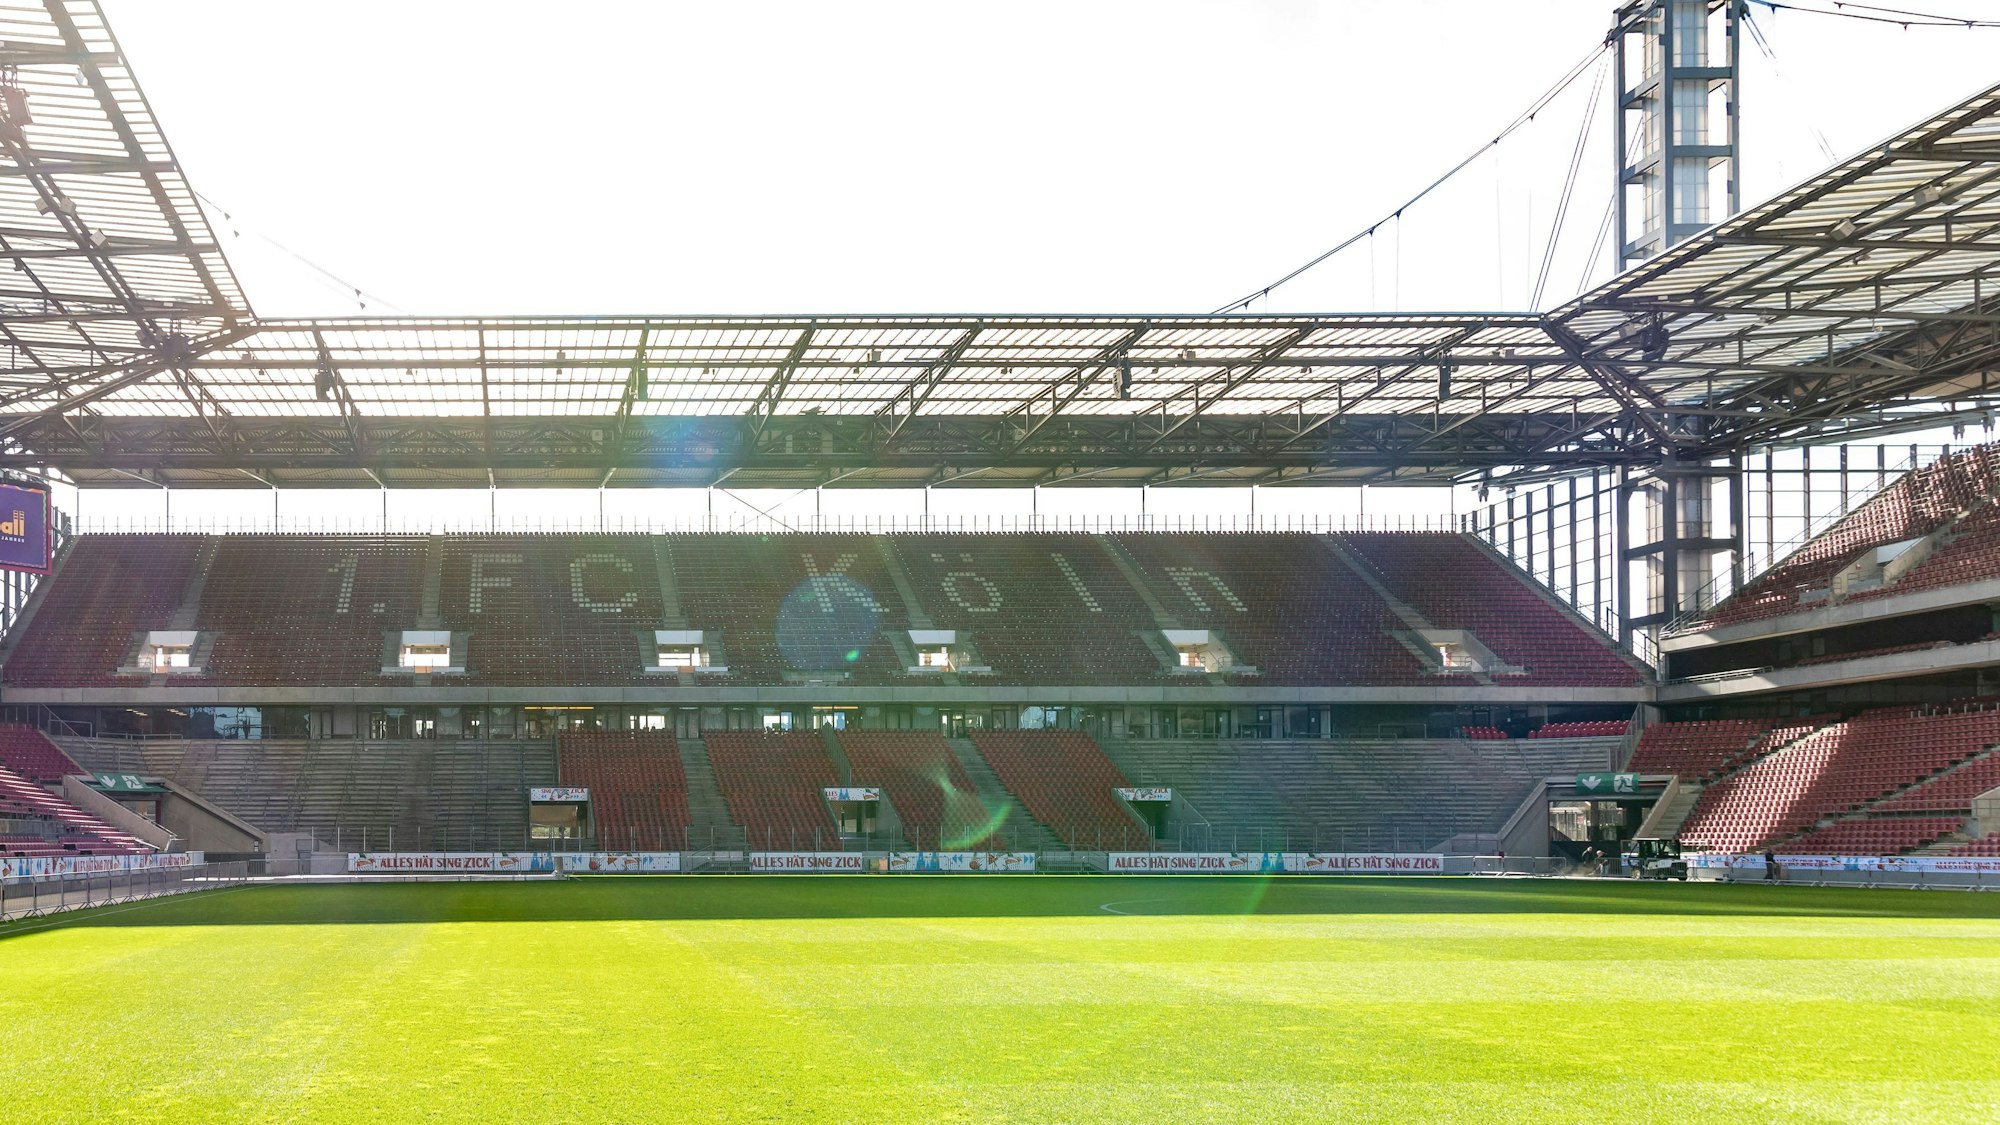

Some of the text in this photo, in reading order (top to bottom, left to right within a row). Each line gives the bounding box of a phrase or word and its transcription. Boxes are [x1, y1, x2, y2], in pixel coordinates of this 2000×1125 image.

[0, 510, 25, 537] all
[328, 553, 1248, 613] 1. FC Köln
[381, 855, 490, 868] ALLES HÄT SING ZICK
[752, 855, 861, 868] ALLES HÄT SING ZICK
[1115, 856, 1225, 868] ALLES HÄT SING ZICK
[1328, 855, 1439, 868] ALLES HÄT SING ZICK
